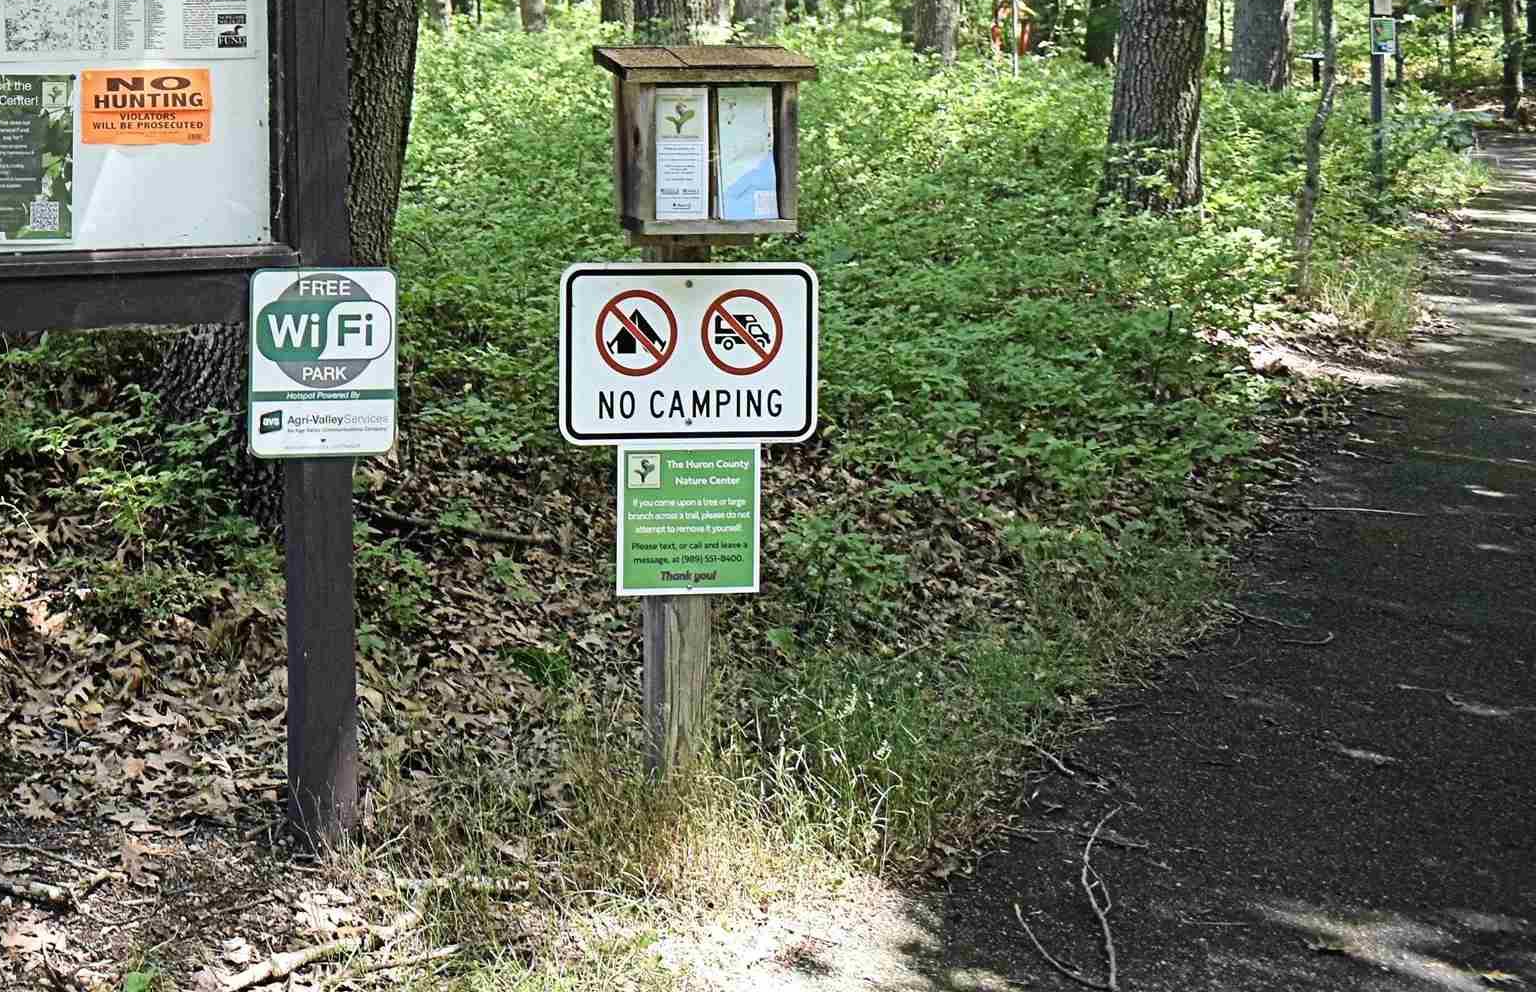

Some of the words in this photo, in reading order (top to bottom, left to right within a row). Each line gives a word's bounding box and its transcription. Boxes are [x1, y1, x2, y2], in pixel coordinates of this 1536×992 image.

[13, 79, 32, 91] the
[105, 76, 192, 92] NO
[94, 92, 204, 109] HUNTING
[119, 111, 177, 121] VIOLATORS
[92, 121, 117, 130] WILL
[120, 121, 135, 129] BE
[137, 120, 204, 129] PROSECUTED
[298, 279, 352, 297] FREE
[302, 366, 347, 382] PARK
[286, 391, 316, 401] Hotspot
[316, 391, 349, 400] Powered
[350, 390, 361, 400] By
[599, 390, 636, 419] NO
[650, 389, 783, 418] CAMPING
[666, 459, 684, 469] The
[686, 459, 714, 469] Huron
[716, 459, 750, 470] County
[675, 476, 707, 486] Nature
[709, 475, 740, 485] Center
[677, 499, 696, 508] upon
[627, 511, 654, 520] branch
[631, 542, 658, 551] Please
[688, 541, 702, 549] call
[704, 541, 719, 549] and
[721, 541, 741, 549] leave
[660, 570, 692, 582] Thank
[693, 570, 718, 583] you!
